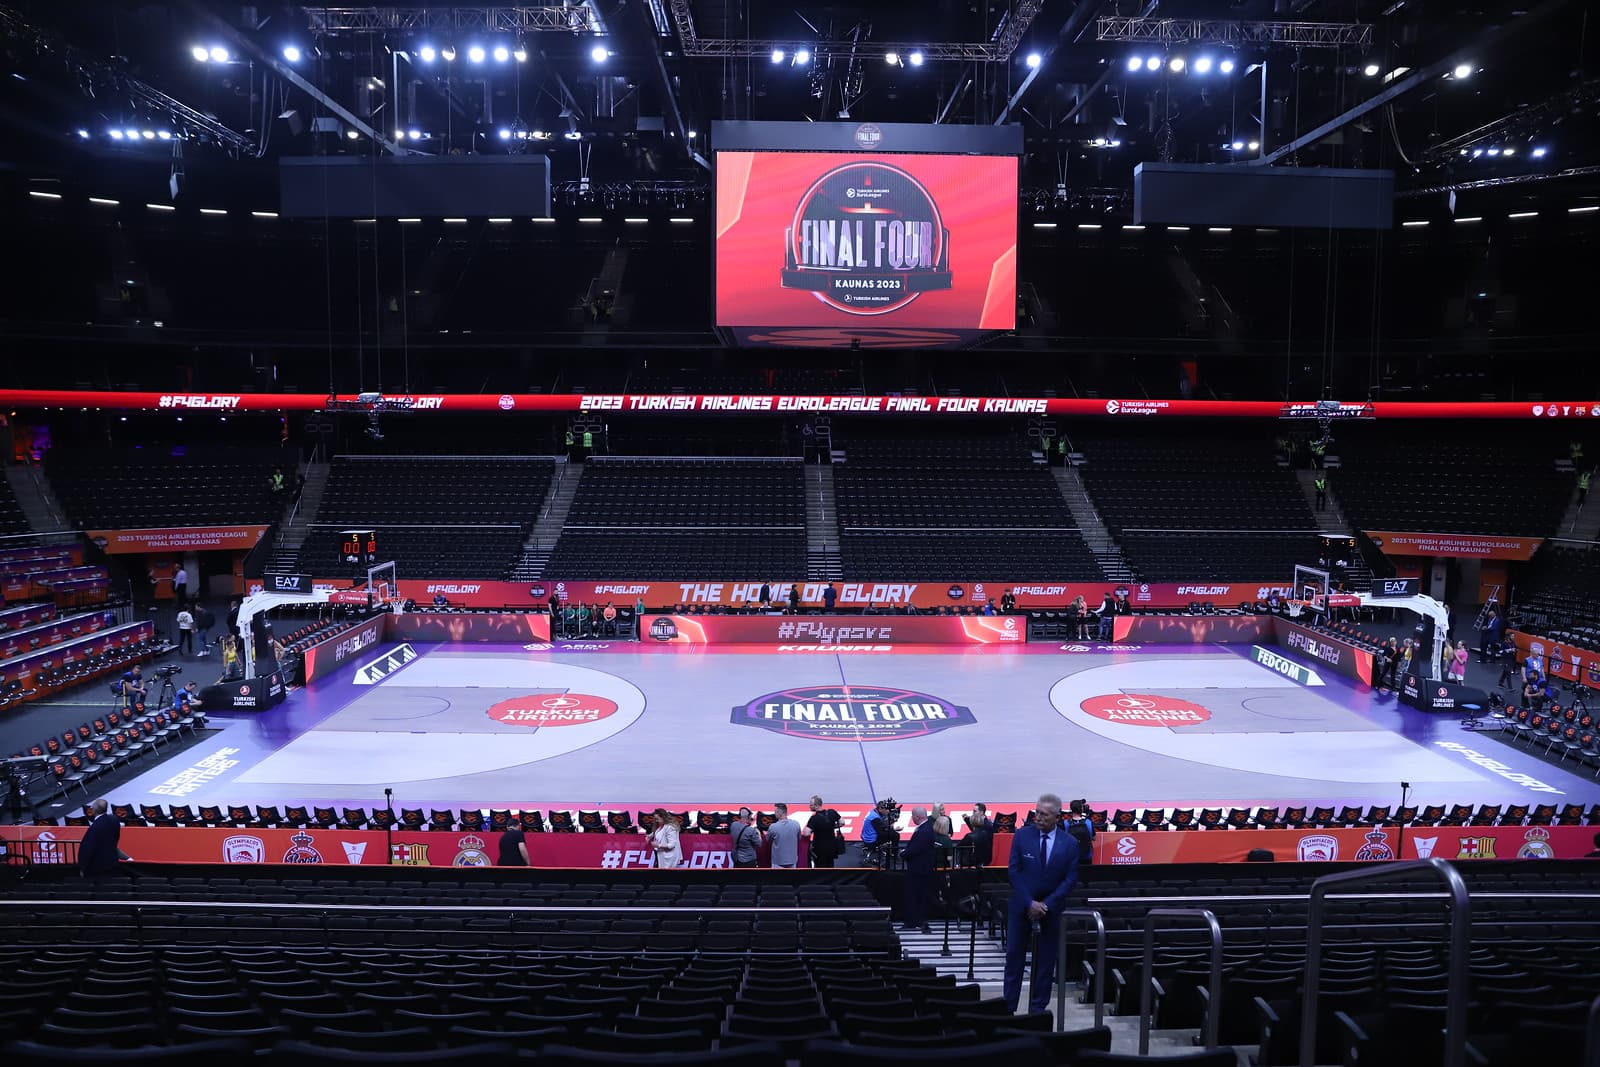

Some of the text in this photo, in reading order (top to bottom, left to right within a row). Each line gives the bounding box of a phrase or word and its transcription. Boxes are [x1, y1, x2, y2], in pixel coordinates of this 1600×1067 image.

[802, 220, 932, 269] FINAL FOUR
[836, 280, 900, 288] KAUNAS 2023
[159, 396, 240, 408] #F4GLORY
[580, 396, 1048, 413] 2023 TURKISH AIRLINES EUROLEAGUE FINAL FOUR KAUNAS
[276, 576, 300, 587] EA7
[1384, 581, 1408, 592] EA7
[427, 585, 481, 594] #F4GLORY
[594, 586, 650, 594] #F4GLORY
[680, 584, 724, 602] THE
[730, 584, 793, 602] HOME
[840, 584, 917, 602] GLORY
[1012, 586, 1066, 596] #F4GLORY
[1177, 586, 1230, 595] #F4GLORY
[1258, 649, 1300, 680] FEDCOM
[1404, 690, 1418, 698] AIRLINES
[764, 704, 949, 722] FINAL FOUR
[148, 746, 240, 795] EVERY GAME
[1432, 741, 1567, 795] #F4GLORY
[168, 760, 240, 796] MATTERS
